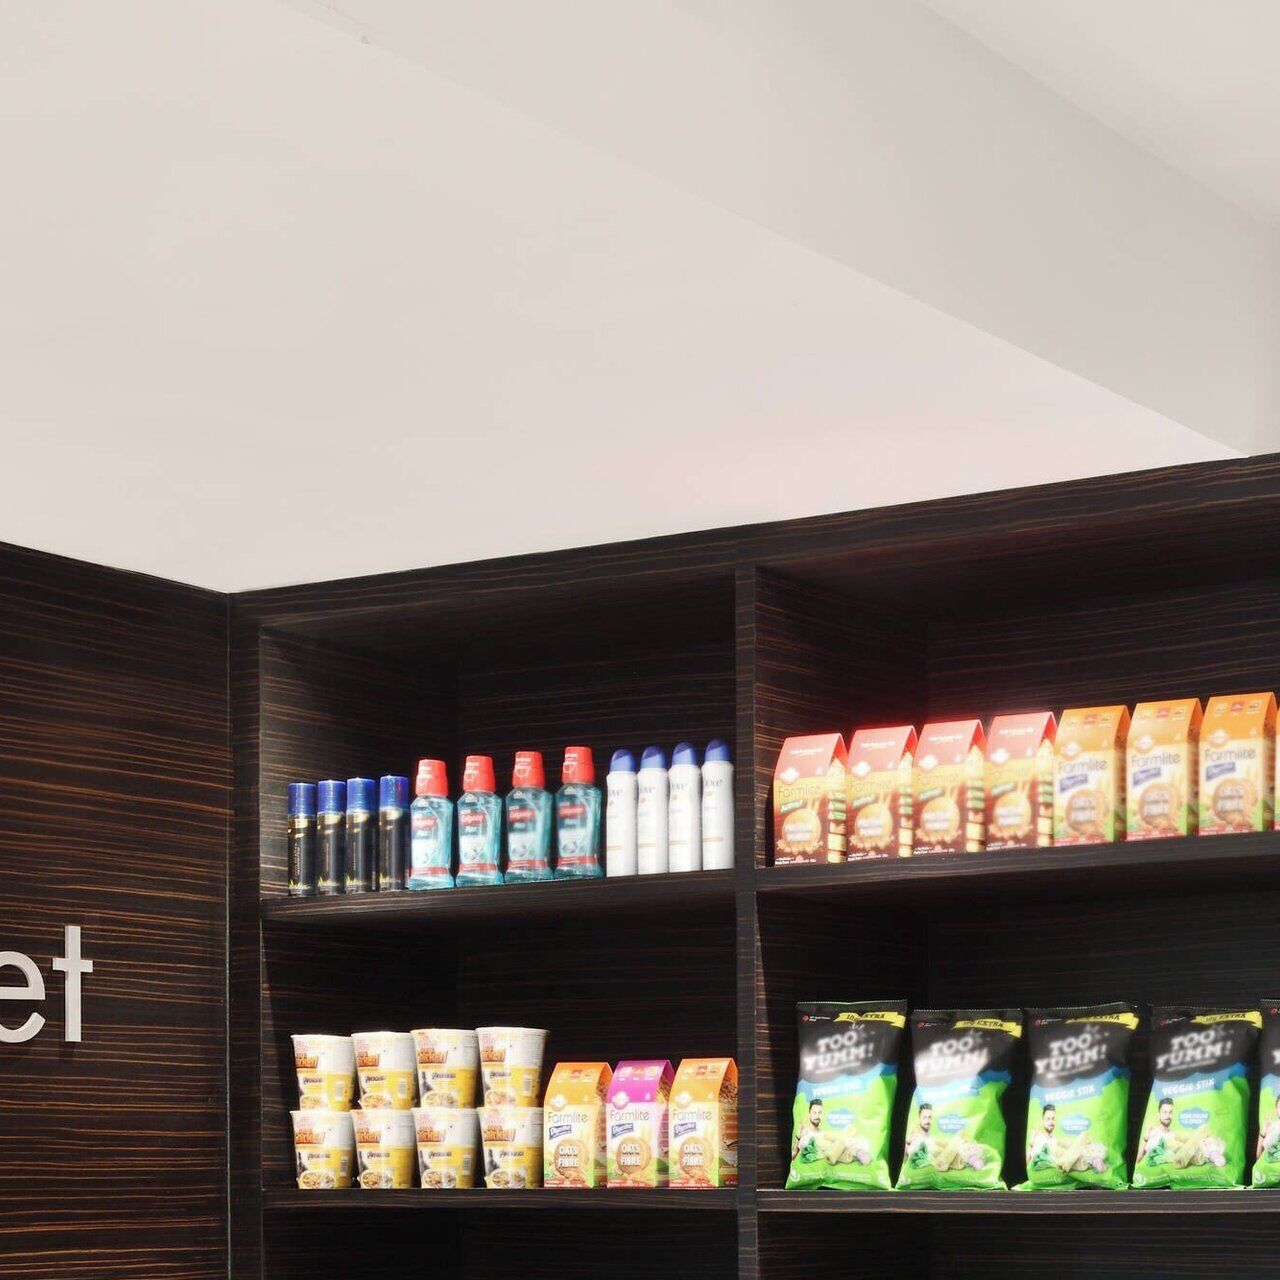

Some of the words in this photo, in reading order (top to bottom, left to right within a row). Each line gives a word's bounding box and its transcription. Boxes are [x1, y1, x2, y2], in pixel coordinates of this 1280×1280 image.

[1131, 753, 1181, 767] Farmlite
[1205, 747, 1256, 761] Farmlite
[1049, 1033, 1092, 1057] TOO
[1171, 1028, 1216, 1050] TOO
[1162, 1084, 1195, 1096] VEGGIE
[1196, 1077, 1216, 1090] STIX
[548, 1111, 588, 1123] Farmlite
[610, 1109, 650, 1122] Farmlite
[673, 1109, 712, 1121] Farmlite
